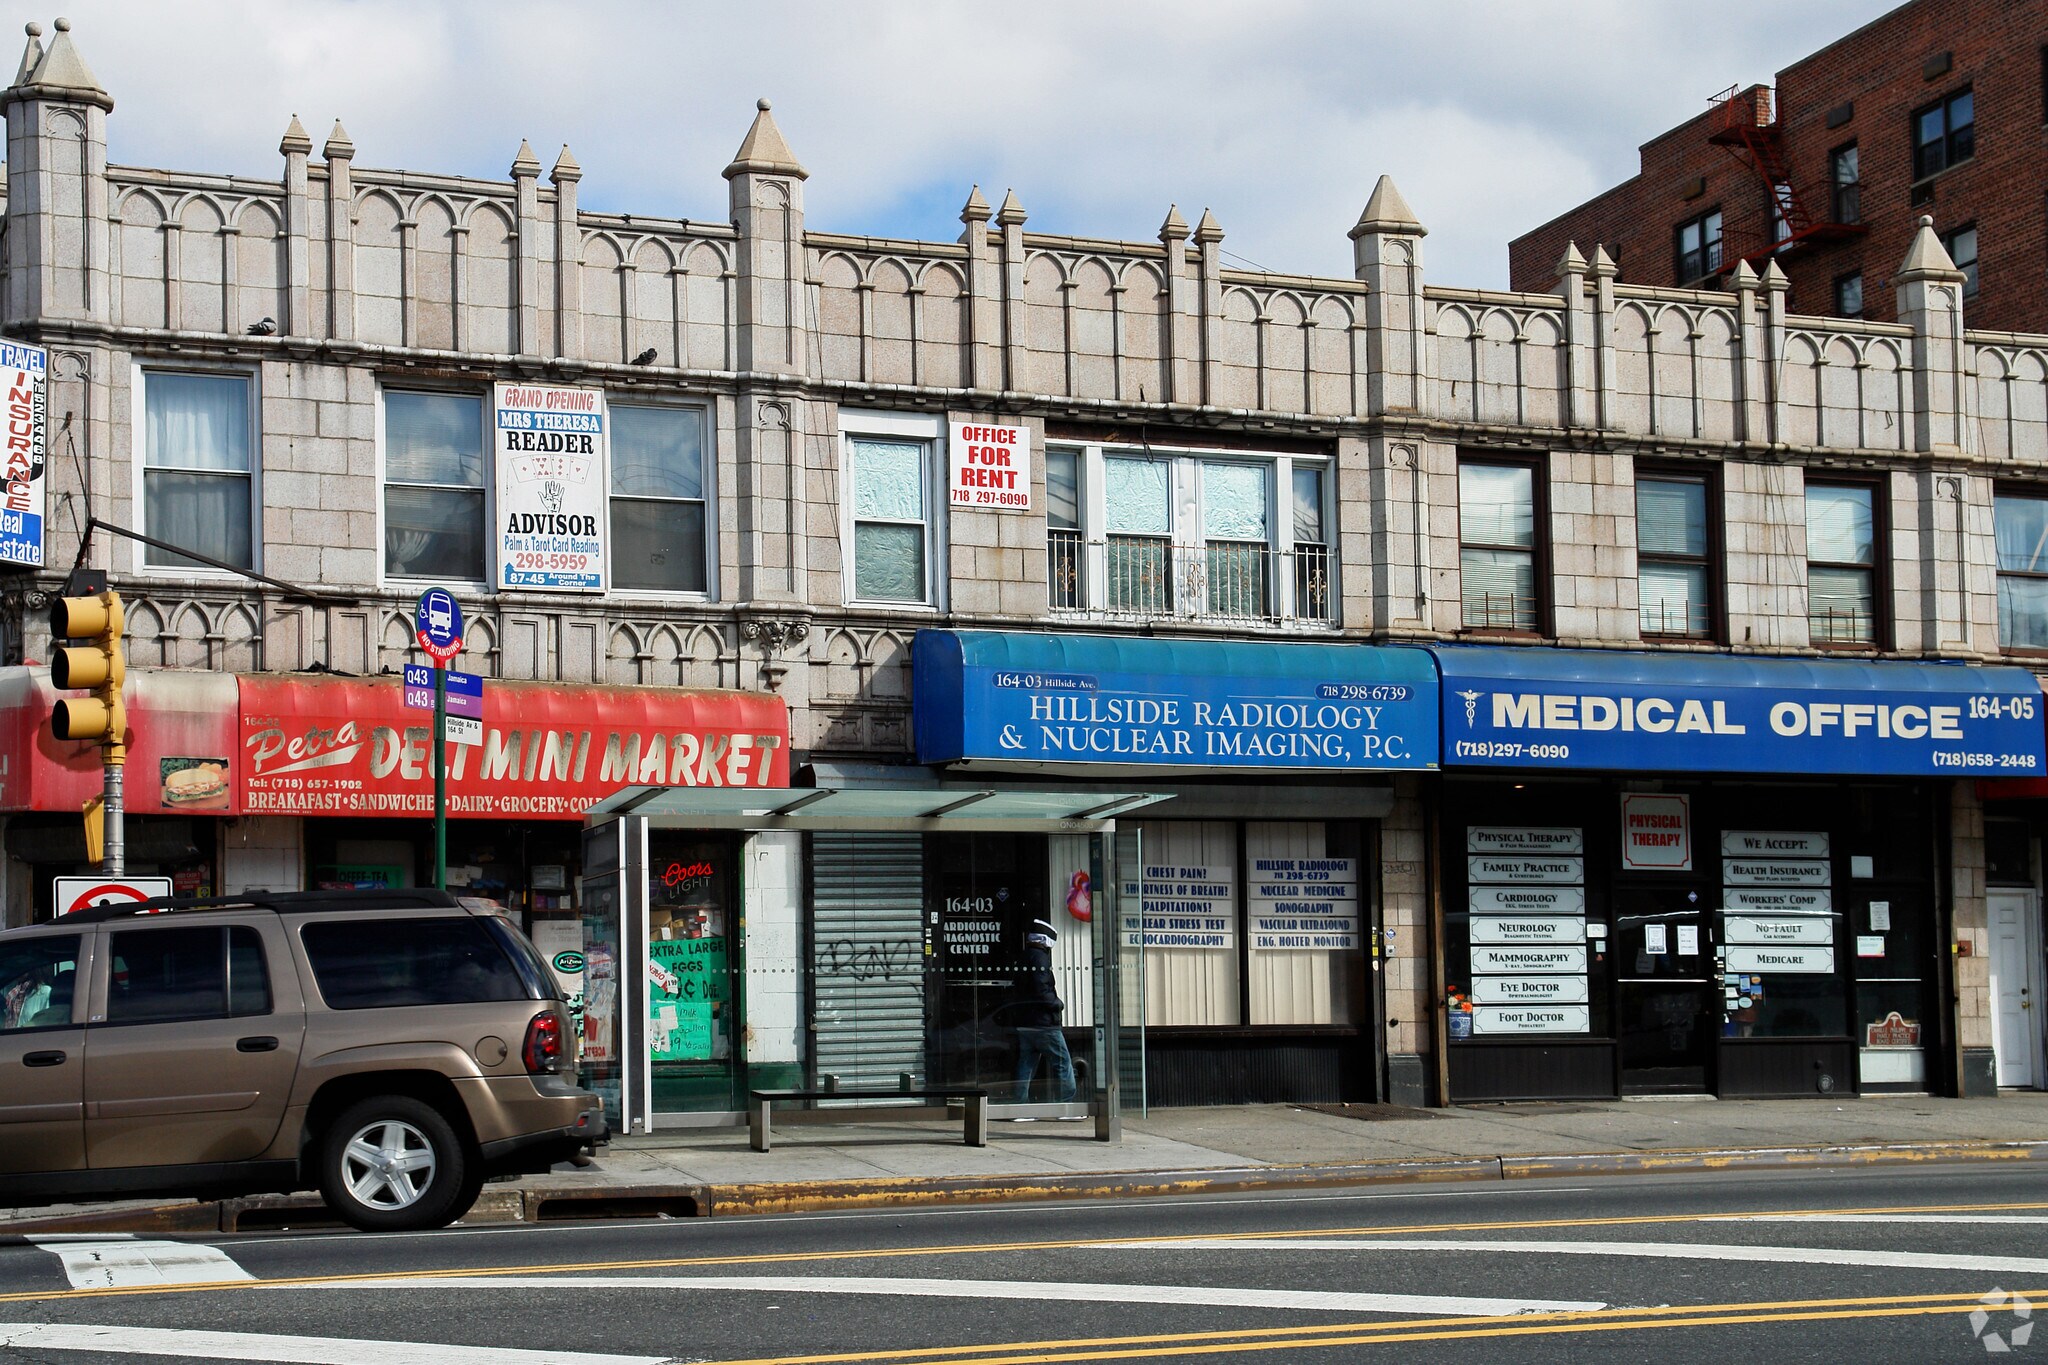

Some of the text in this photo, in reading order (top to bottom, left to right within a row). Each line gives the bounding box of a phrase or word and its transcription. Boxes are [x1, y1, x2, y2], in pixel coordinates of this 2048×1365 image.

[0, 342, 44, 373] TRAVEL
[505, 388, 594, 411] GRAND OPENING
[500, 411, 600, 432] MRS THERESA
[6, 372, 33, 512] INSURANCE
[506, 431, 595, 455] READER
[962, 426, 1017, 445] OFFICE
[968, 445, 1011, 467] FOR
[961, 467, 1018, 490] RENT
[952, 489, 1028, 506] 718 297-6090
[507, 513, 597, 537] ADVISOR
[504, 535, 600, 558] Palm & Tarot Card Reading
[515, 552, 588, 570] 298-5959
[509, 572, 546, 584] 87-45
[421, 633, 460, 657] NO STANDING
[407, 668, 468, 685] Q43 Jamaica
[996, 673, 1096, 689] 164-03 Hillside Ave.
[407, 690, 428, 707] Q43
[447, 695, 467, 706] Jamaica
[1322, 685, 1407, 700] 718 298-6739
[1029, 696, 1383, 731] HILLSIDE RADIOLOGY
[1968, 696, 2035, 720] 164-05
[447, 718, 465, 728] Hillside
[1492, 693, 1965, 740] MEDICAL OFFICE
[246, 720, 364, 773] Petra
[999, 724, 1412, 762] & NUCLEAR IMAGING, P.C.
[1455, 740, 1570, 759] (718)297-6090
[479, 728, 591, 783] MINI
[599, 732, 781, 787] MARKET
[1932, 750, 2037, 769] (718)658-2448
[248, 777, 363, 790] Tel: (718) 657-1902
[248, 791, 342, 810] BREAKAFAST
[349, 793, 435, 811] SANDWICHE
[451, 795, 494, 812] DAIRY
[501, 796, 565, 813] GROCERY
[1629, 814, 1682, 829] PHYSICAL
[1477, 832, 1573, 843] PHYSICAL THERAPY
[1632, 832, 1681, 847] THERAPY
[1146, 866, 1207, 879] CHEST PAIN?
[1256, 860, 1348, 871] HILLSIDE RADIOLOGY
[1483, 862, 1570, 873] FAMILY PRACTICE
[1732, 865, 1822, 876] HEALTH INSURANCE
[661, 862, 714, 887] Coors
[1286, 871, 1330, 880] 298-6739
[669, 876, 711, 899] LIGHT
[1176, 884, 1188, 895] OF
[1260, 885, 1346, 897] NUCLEAR MEDICINE
[945, 897, 994, 913] 164-03
[1496, 892, 1558, 903] CARDIOLOGY
[1789, 895, 1817, 905] COMP
[1143, 901, 1212, 913] PALPITATIONS?
[1275, 902, 1334, 913] SONOGRAPHY
[943, 921, 1002, 932] ARDIOLOGY
[1125, 917, 1225, 930] NULEAR STRESS TEST
[1259, 919, 1350, 930] VASCULAR ULTRASOUND
[1498, 922, 1558, 932] NEUROLOGY
[649, 941, 724, 958] EXTRA LARGE
[950, 944, 990, 955] CENTER
[1279, 936, 1311, 947] HOLTER
[1314, 936, 1351, 947] MONITOR
[1488, 953, 1570, 963] MAMMOGRAPHY
[1757, 954, 1804, 964] MEDICARE
[1500, 982, 1560, 992] EYE DOCTOR
[1499, 1012, 1564, 1022] FOOT DOCTOR
